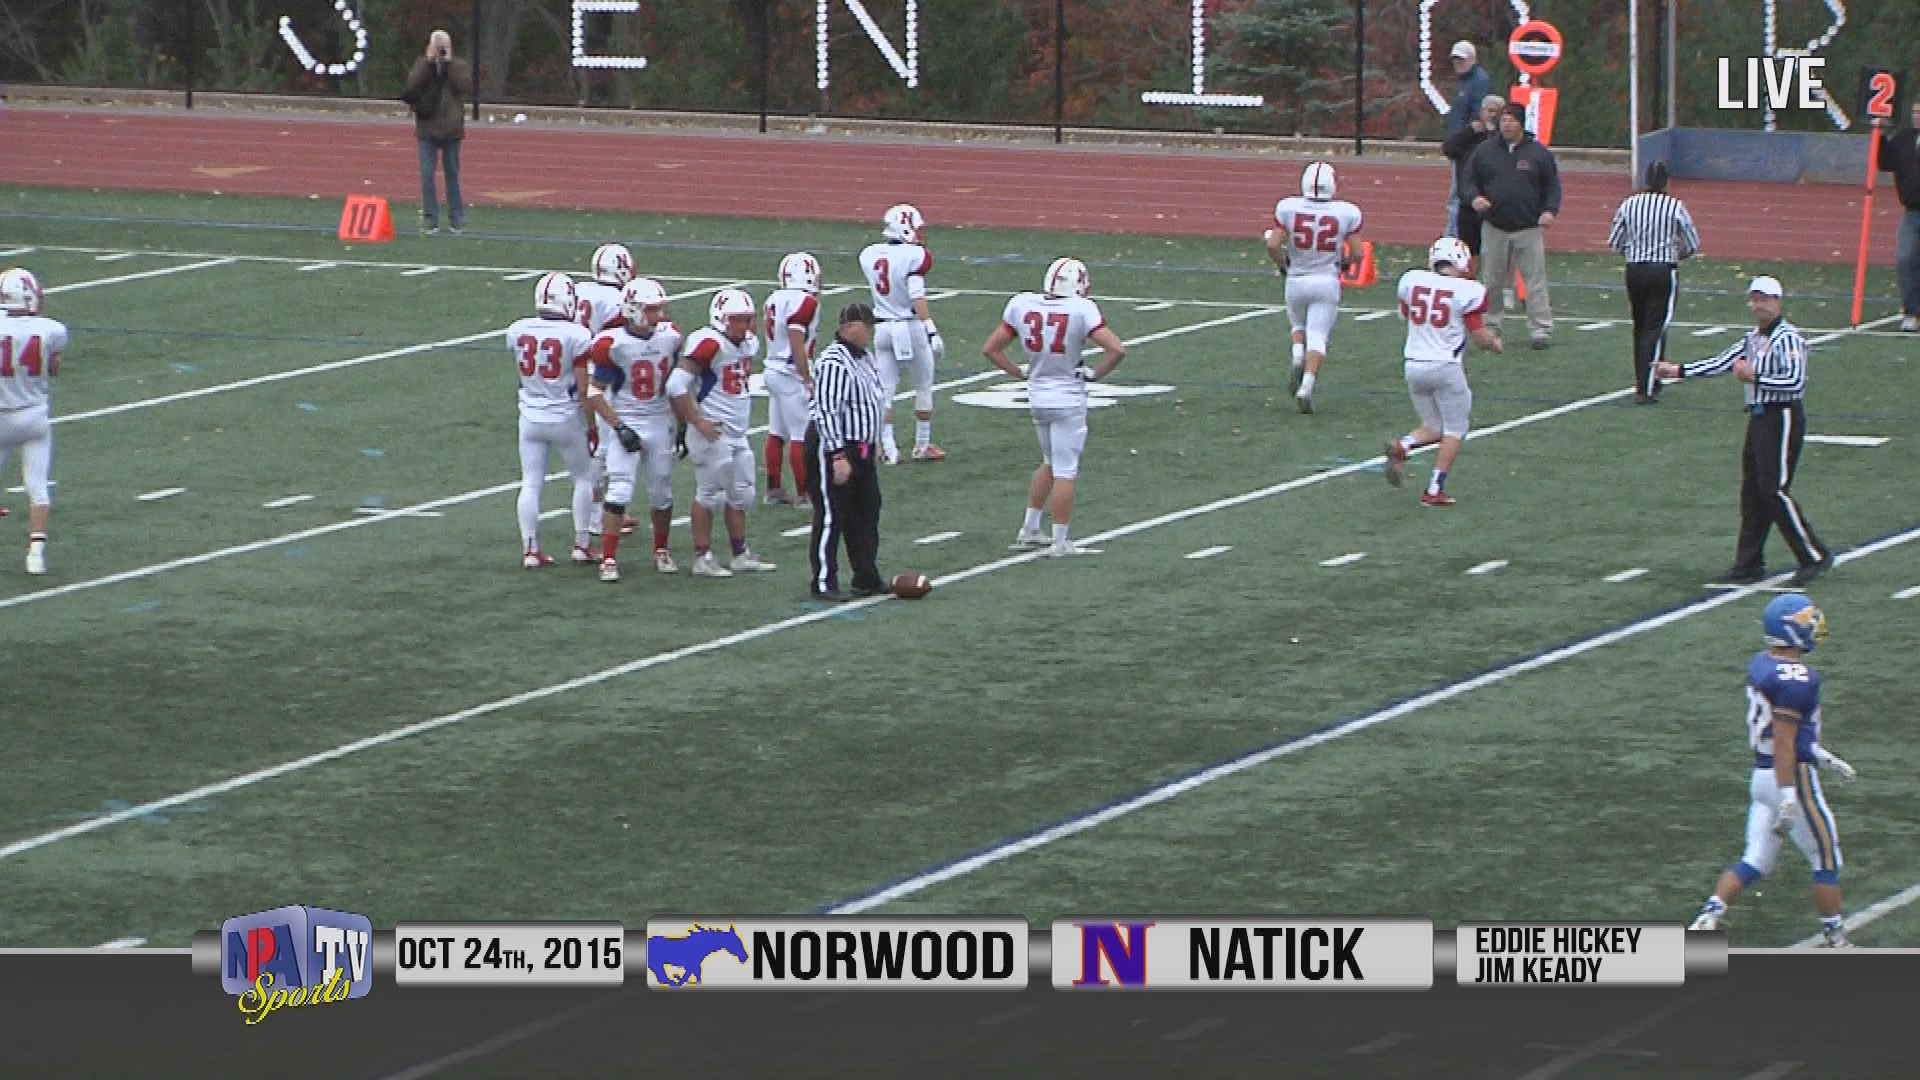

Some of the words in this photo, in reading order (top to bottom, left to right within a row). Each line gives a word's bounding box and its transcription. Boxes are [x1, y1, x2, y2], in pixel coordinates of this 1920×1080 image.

[1867, 71, 1896, 117] 2
[348, 203, 377, 236] 10
[1293, 213, 1340, 251] 52
[873, 257, 890, 295] 3
[1410, 285, 1454, 329] 55
[1023, 311, 1069, 354] 37
[0, 334, 42, 377] 14
[516, 335, 563, 379] 33
[630, 357, 669, 400] 81
[1776, 663, 1809, 682] 32
